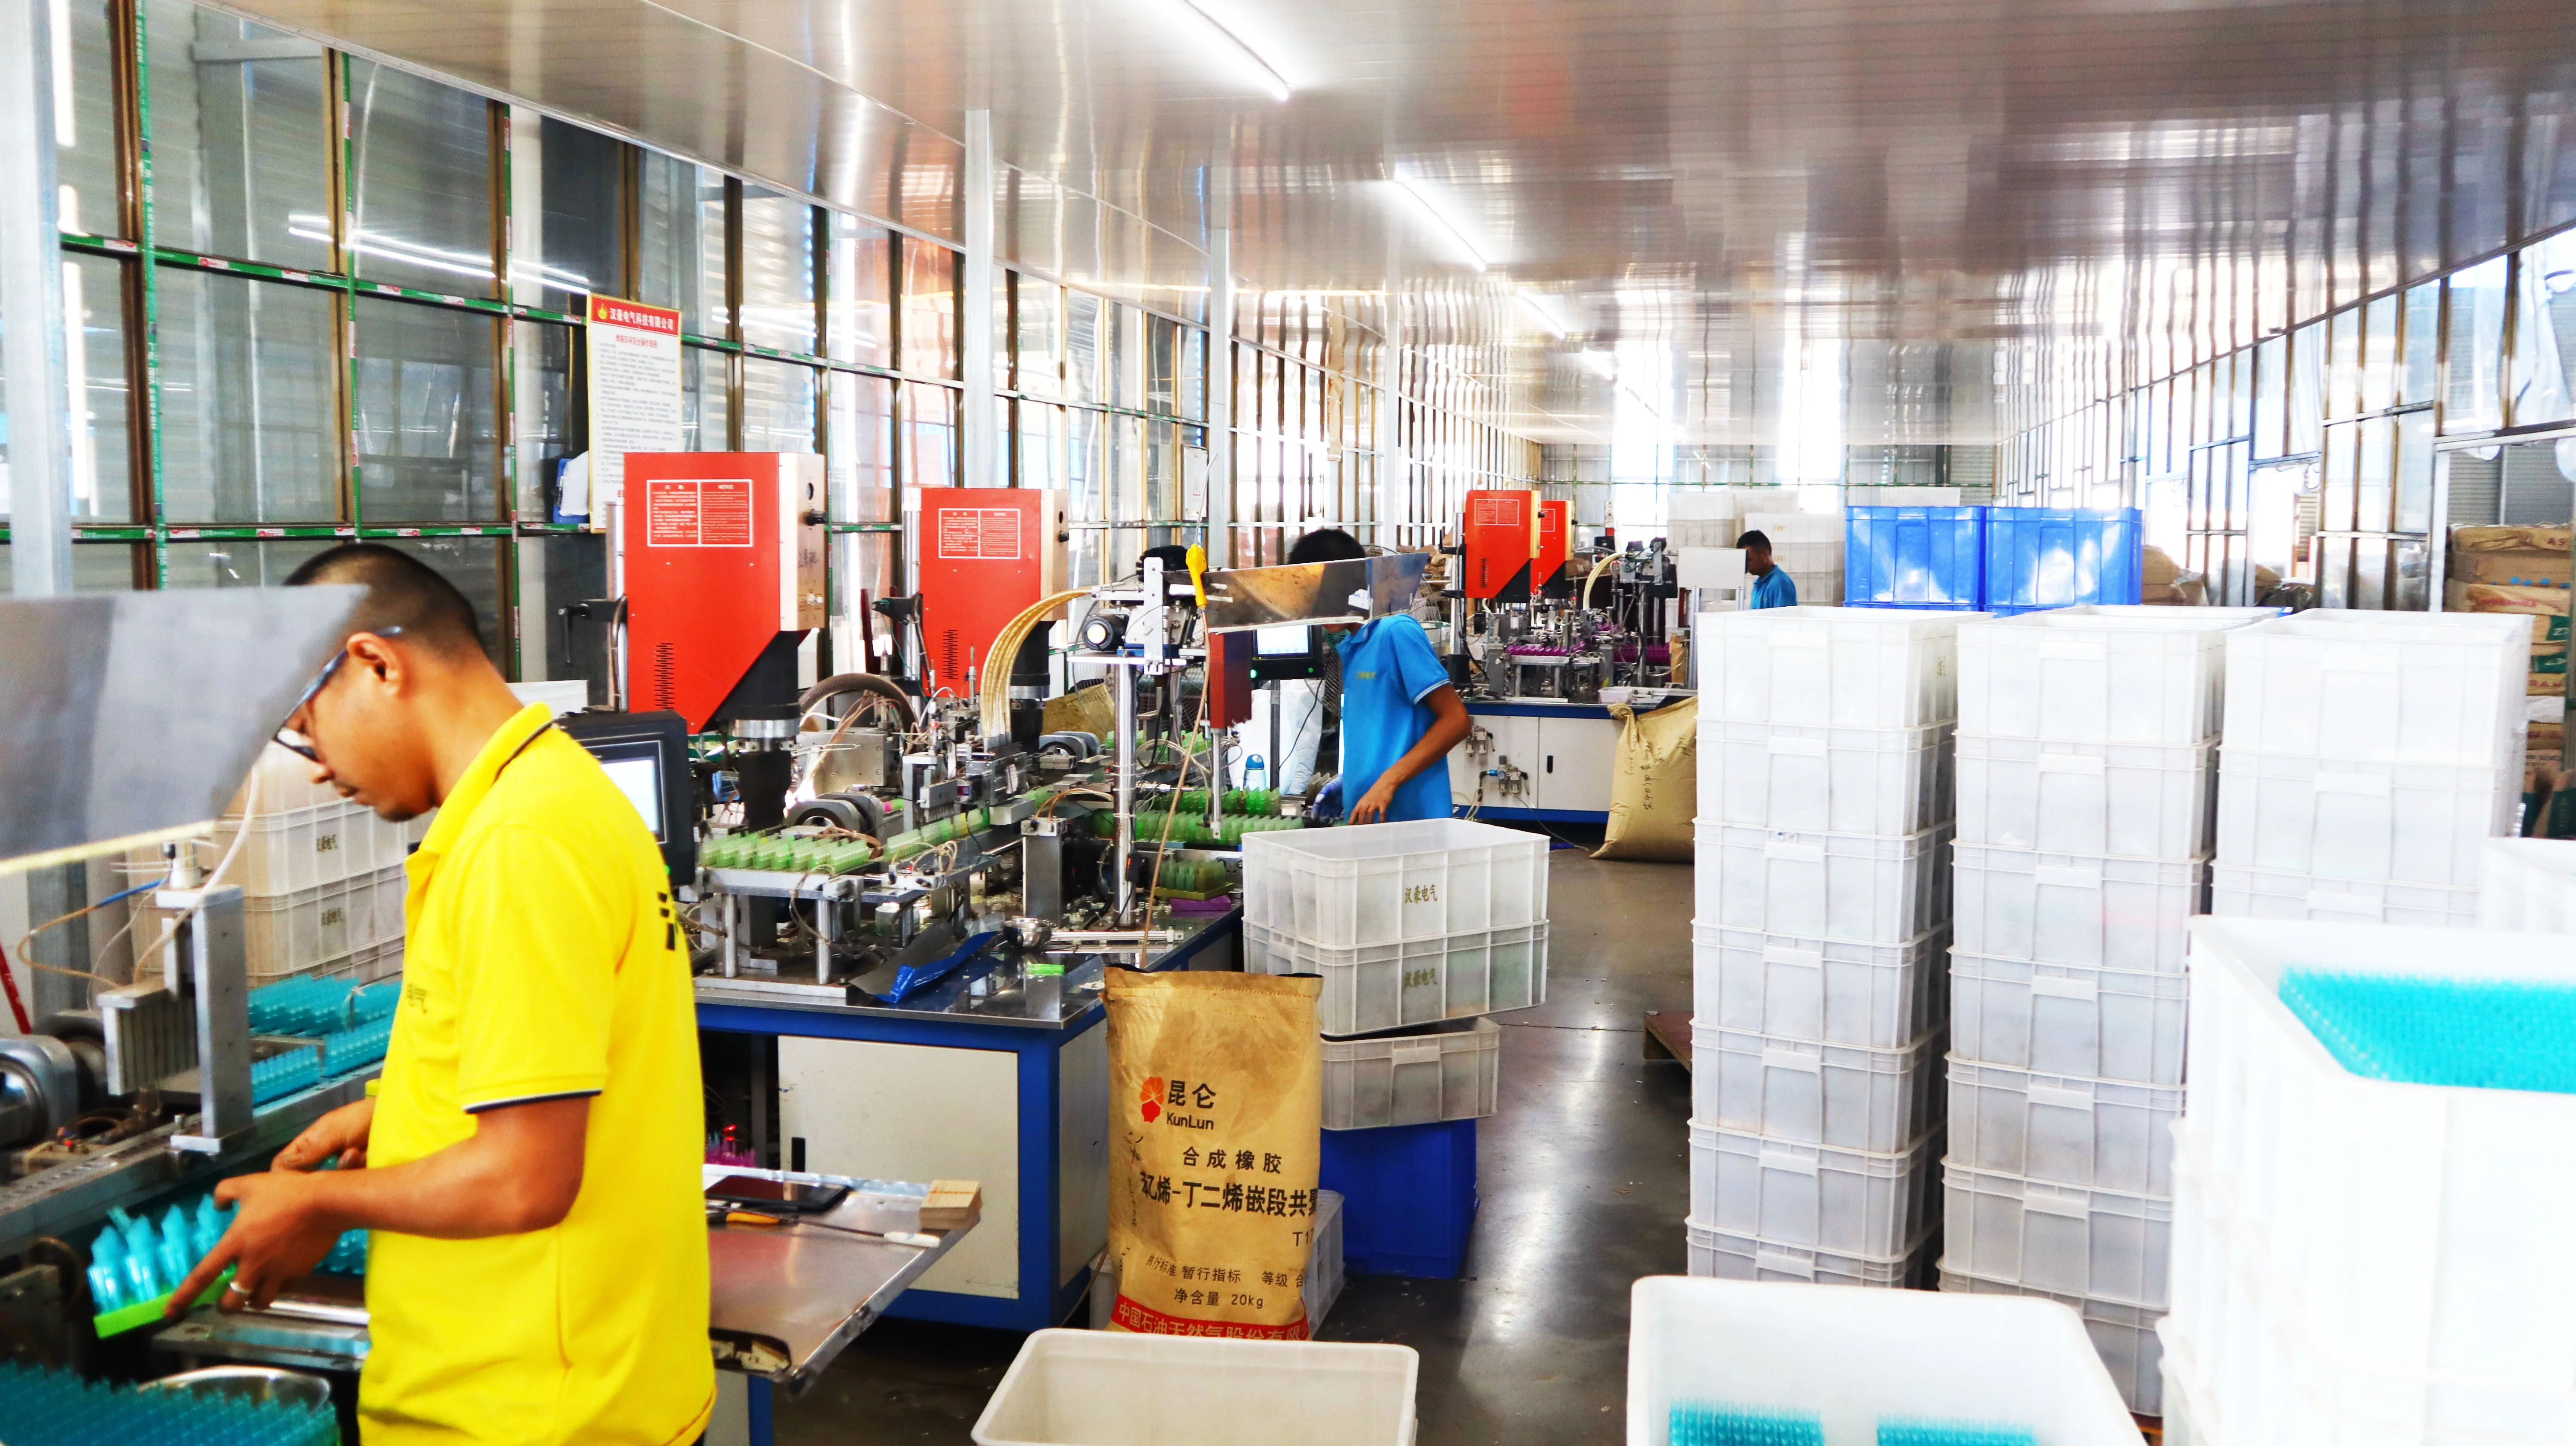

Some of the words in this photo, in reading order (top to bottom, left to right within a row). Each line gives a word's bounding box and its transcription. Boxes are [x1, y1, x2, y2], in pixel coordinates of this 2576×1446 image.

[1167, 1079, 1216, 1109] 昆仑
[1166, 1112, 1214, 1130] KunLun
[1183, 1146, 1282, 1174] 合成橡胶
[1182, 1265, 1241, 1283] 暂行指标
[1262, 1271, 1288, 1287] 等级
[1174, 1288, 1220, 1306] 净含量
[1231, 1294, 1264, 1309] 20kg
